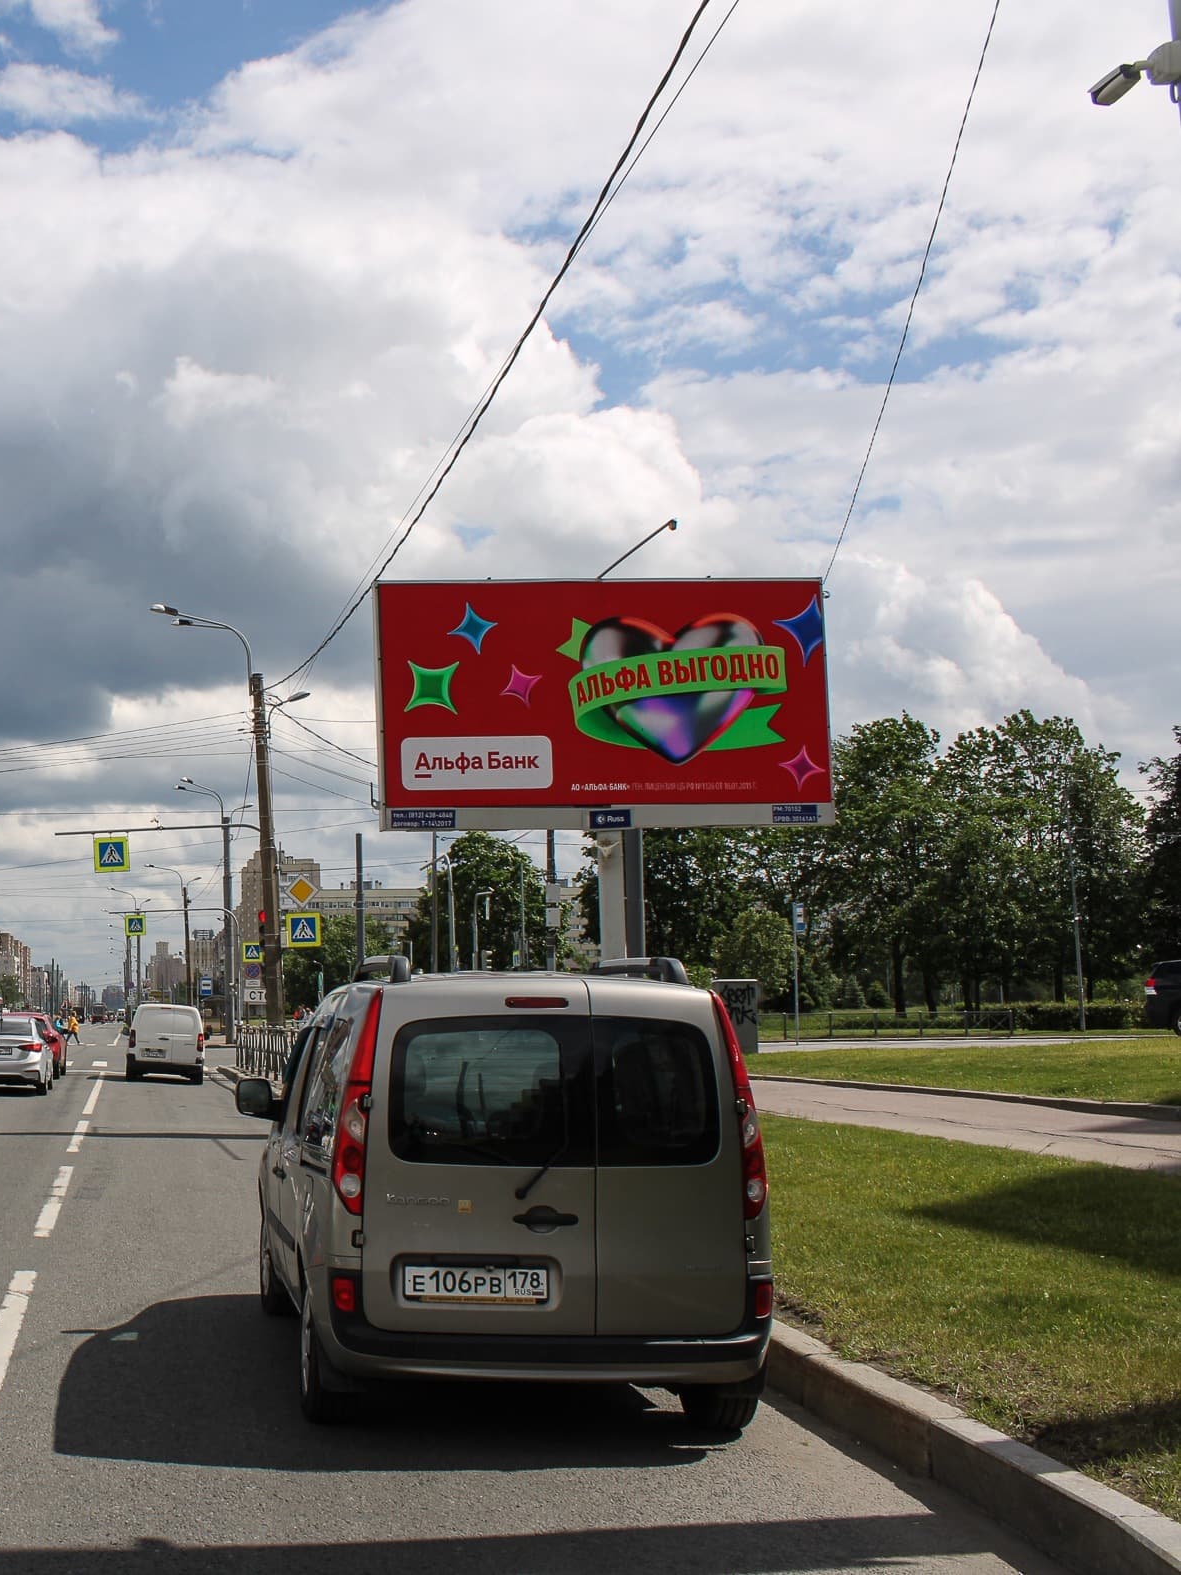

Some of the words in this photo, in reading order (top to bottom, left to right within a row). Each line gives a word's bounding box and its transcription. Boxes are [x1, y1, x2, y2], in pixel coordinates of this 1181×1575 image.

[576, 663, 652, 707] АЛЬФА
[657, 654, 780, 686] ВЫГОДНО
[414, 751, 484, 776] Альфа
[487, 751, 540, 770] Банк
[571, 783, 580, 791] АО
[606, 815, 625, 823] Russ
[249, 990, 267, 1001] СТ
[412, 1270, 503, 1295] Е106РВ
[507, 1271, 541, 1289] 178
[514, 1288, 532, 1296] RUS
